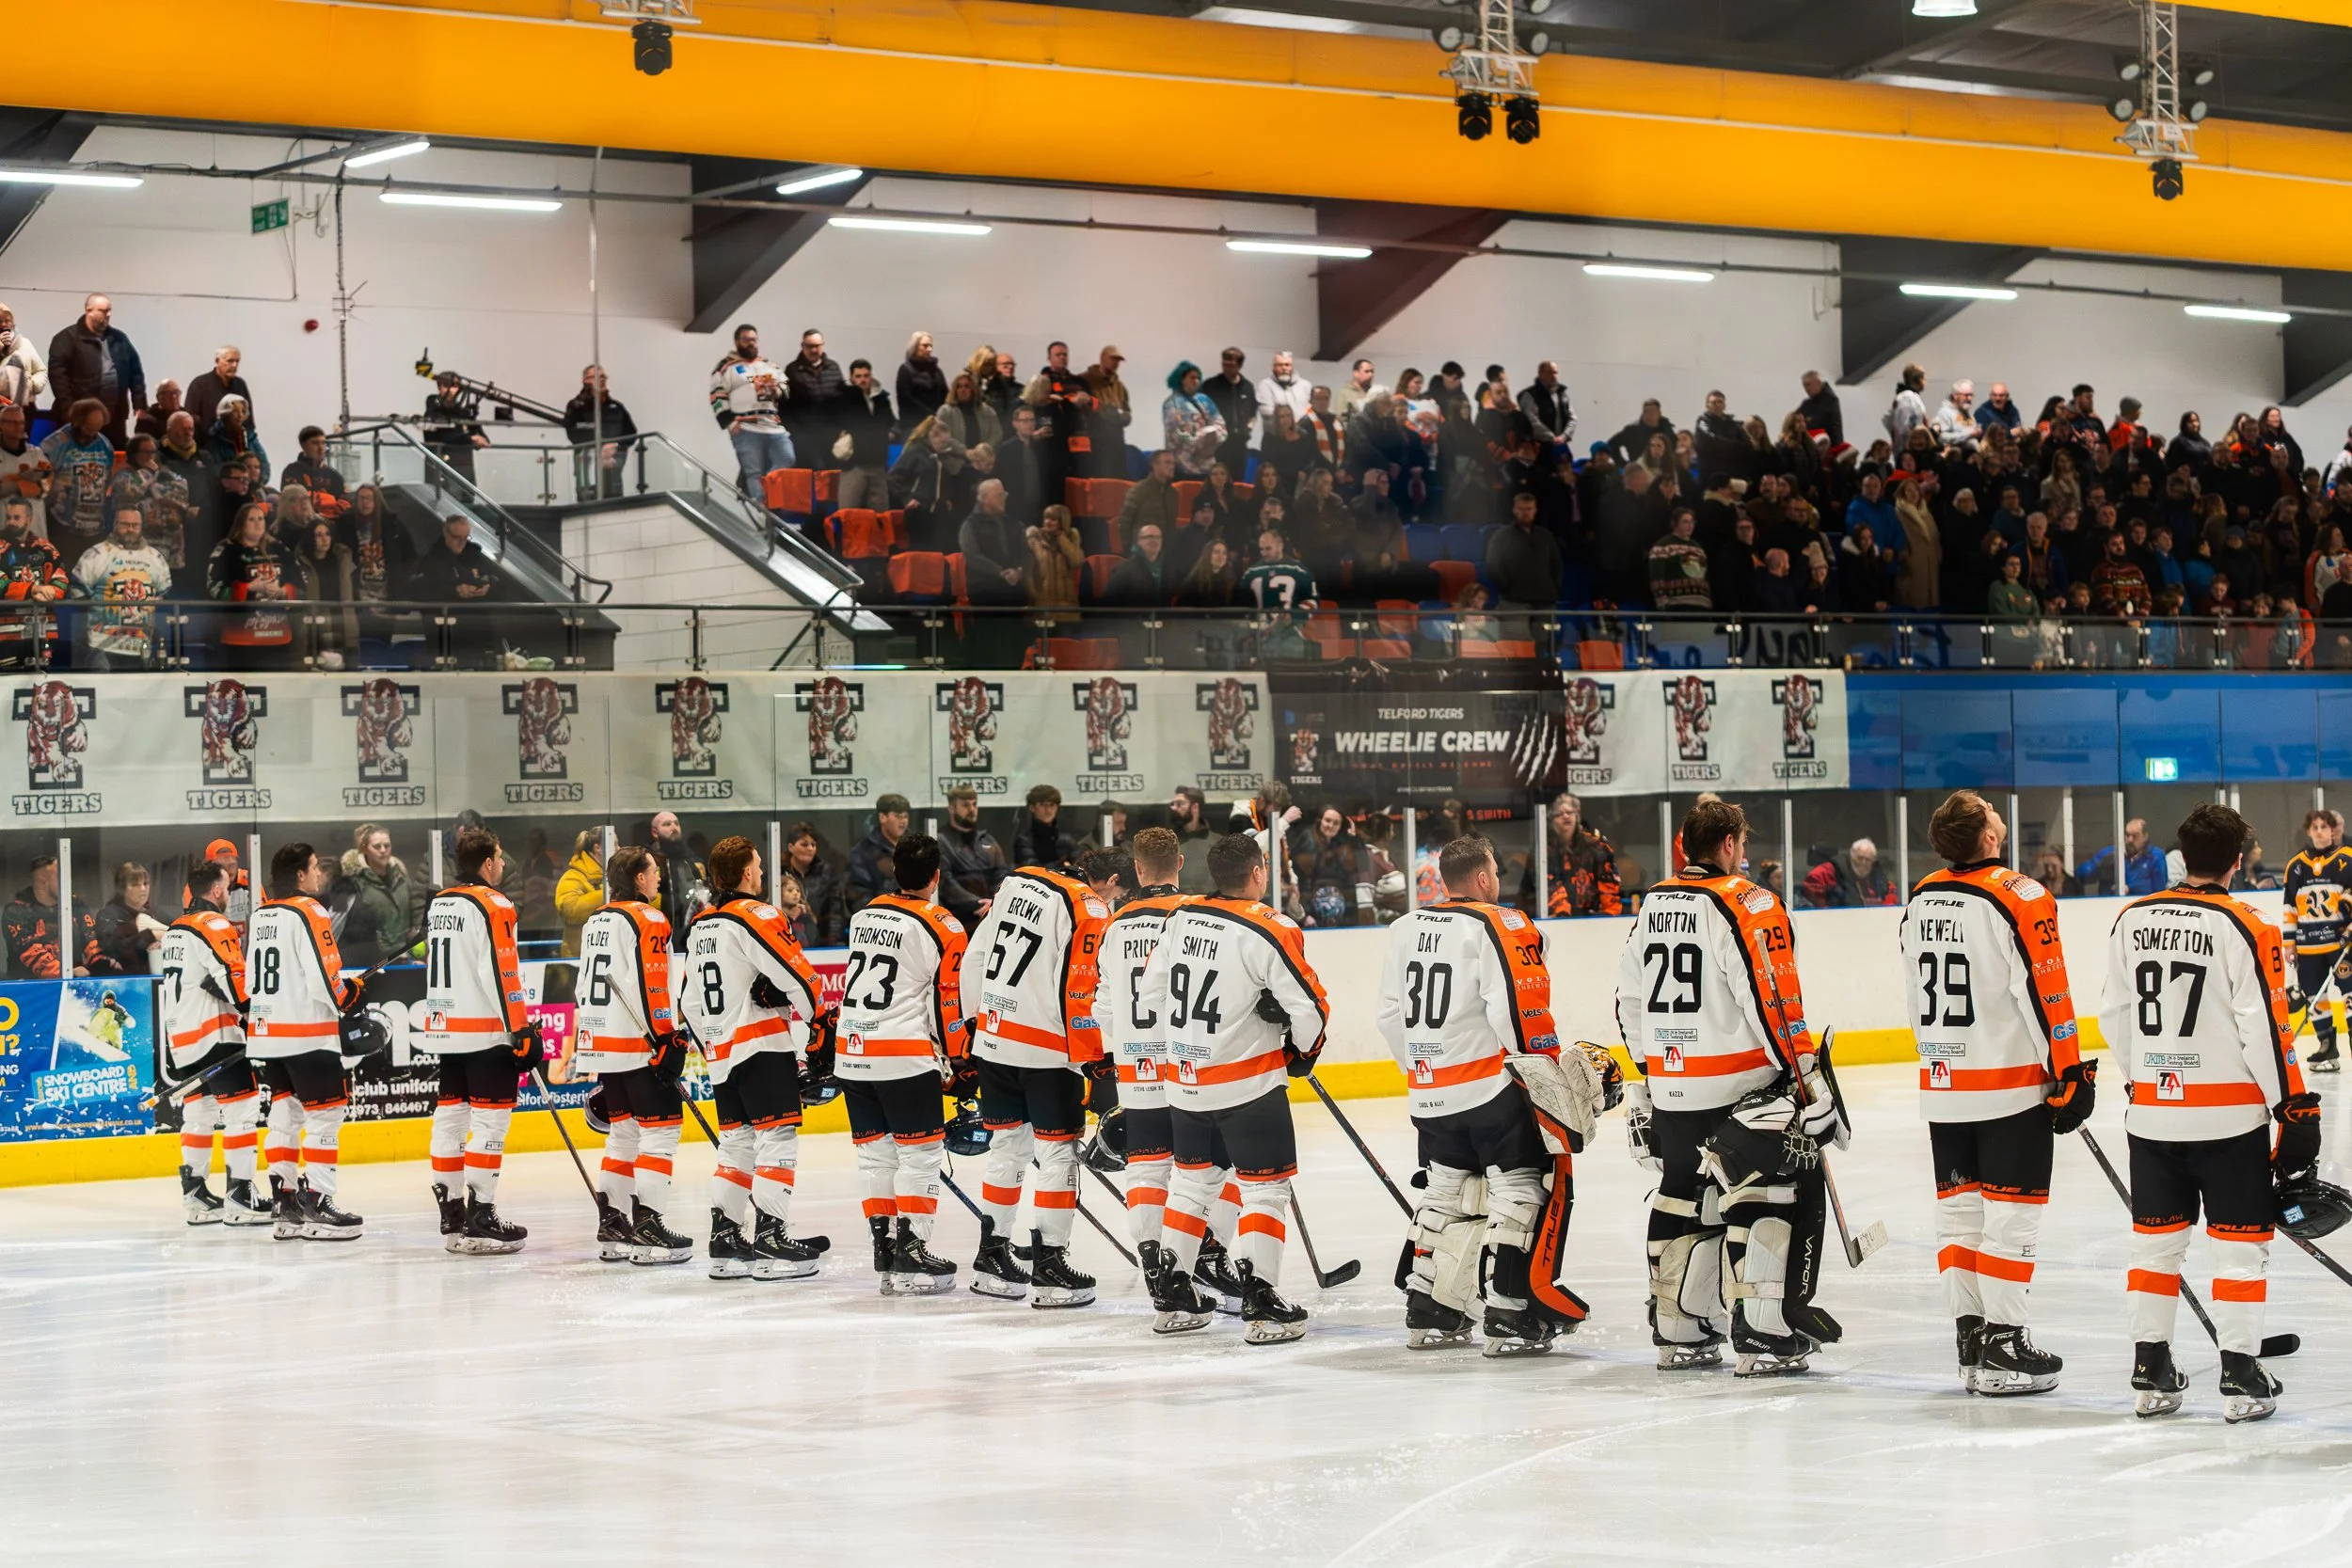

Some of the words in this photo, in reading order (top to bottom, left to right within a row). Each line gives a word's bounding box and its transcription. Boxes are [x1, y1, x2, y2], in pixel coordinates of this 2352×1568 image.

[1377, 707, 1427, 721] TELFORD
[1429, 707, 1464, 720] TIGERS
[1335, 730, 1438, 753] WHEELIE
[1441, 730, 1511, 753] CREW
[1291, 775, 1323, 784] TIGERS
[1567, 768, 1613, 784] IGERS
[1672, 763, 1721, 781] TIGERS
[1772, 761, 1827, 779] TIGERS
[504, 782, 584, 804] TIGERS
[658, 778, 733, 800] TIGERS
[796, 777, 868, 798] TIGERS
[1077, 773, 1145, 793] TIGERS
[1197, 772, 1264, 792] TIGERS
[11, 792, 103, 816] TIGERS
[186, 788, 272, 811] TIGERS
[342, 785, 426, 808] TIGERS
[1477, 808, 1512, 820] SMITH
[1020, 882, 1051, 900] TRUE
[1655, 894, 1697, 902] TRUE
[1007, 896, 1043, 926] BROWN
[1923, 898, 1966, 909] TRUE
[2148, 908, 2202, 919] TRUE
[695, 923, 721, 931] TRUE
[865, 912, 903, 923] TRUE
[1120, 921, 1160, 932] TRUE
[1185, 918, 1226, 931] TRUE
[1415, 913, 1454, 924] TRUE
[1648, 911, 1697, 935] NORTON
[695, 937, 717, 957] ASTON
[852, 927, 903, 950] THOMSON
[1083, 932, 1099, 955] 6
[1182, 935, 1219, 961] SMITH
[1416, 931, 1442, 954] DAY
[1763, 925, 1788, 953] 29
[2133, 927, 2214, 958] SOMERTON
[430, 937, 452, 989] 11
[952, 951, 964, 973] 2
[1515, 943, 1544, 967] 30
[580, 953, 612, 1006] 6
[697, 960, 725, 1017] 8
[842, 950, 899, 1011] 23
[1643, 942, 1704, 1014] 29
[1169, 961, 1222, 1035] 94
[1405, 960, 1454, 1030] 30
[1918, 951, 1977, 1028] 39
[2135, 959, 2208, 1037] 87
[1136, 1057, 1154, 1074] TA
[1664, 1046, 1682, 1065] TA
[43, 1066, 126, 1087] SNOWBOARD
[126, 1064, 138, 1091] AND
[1931, 1060, 1949, 1079] TA
[2158, 1071, 2182, 1090] TA
[44, 1084, 71, 1103] SKI
[72, 1078, 128, 1099] CENTRE
[1981, 1182, 2022, 1194] RUE
[1542, 1199, 1561, 1268] TRUE
[1798, 1234, 1816, 1298] VAPOR
[2180, 1278, 2209, 1323] RUE
